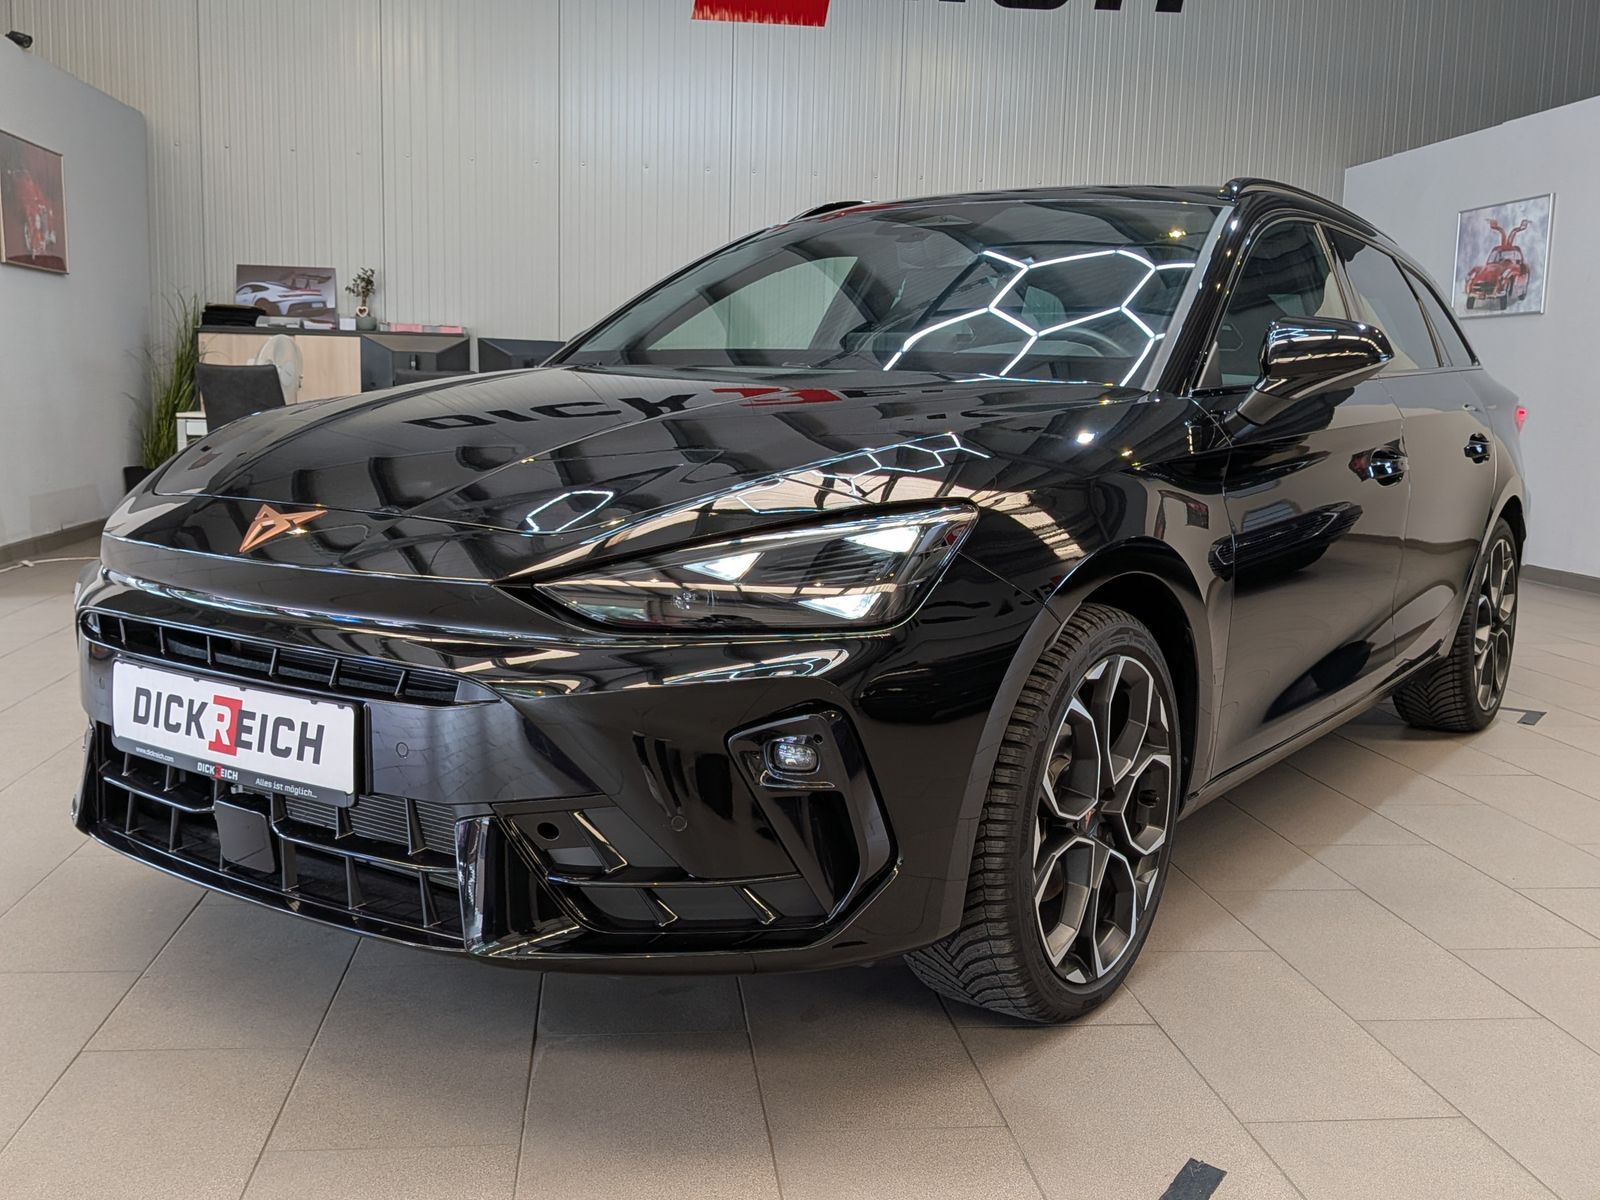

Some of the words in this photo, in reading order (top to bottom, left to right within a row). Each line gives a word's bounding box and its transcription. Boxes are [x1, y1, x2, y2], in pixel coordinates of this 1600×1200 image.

[132, 686, 325, 765] DICKREICH
[197, 762, 239, 781] DICKREICH
[255, 777, 272, 788] Alles
[273, 781, 283, 791] ist
